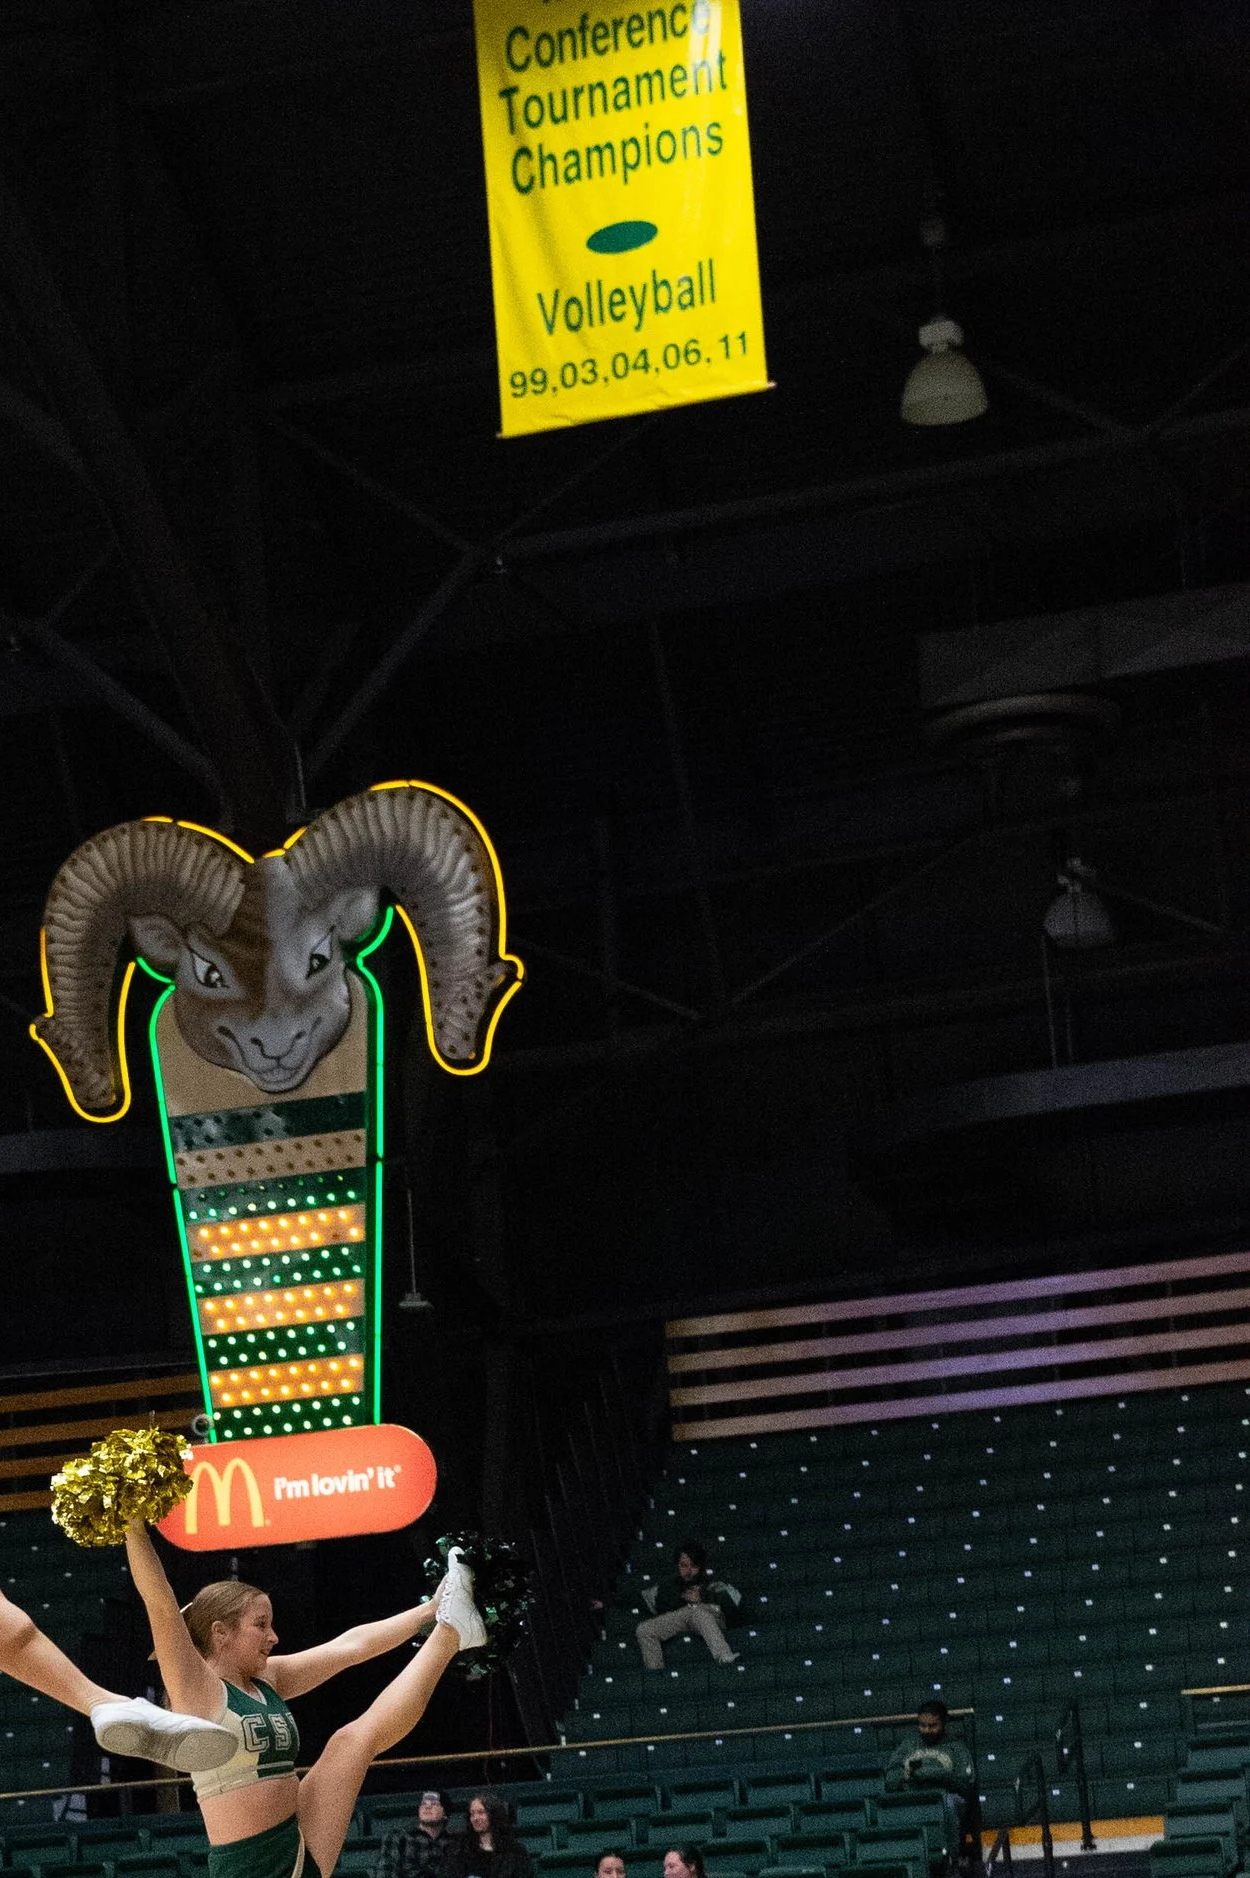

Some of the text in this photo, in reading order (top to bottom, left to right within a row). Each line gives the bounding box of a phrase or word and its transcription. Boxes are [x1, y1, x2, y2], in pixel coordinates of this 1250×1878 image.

[505, 0, 712, 74] Conference
[498, 49, 729, 136] Tournament
[510, 119, 724, 195] Champions
[536, 257, 717, 336] Volleyball
[311, 1466, 374, 1497] lovin'
